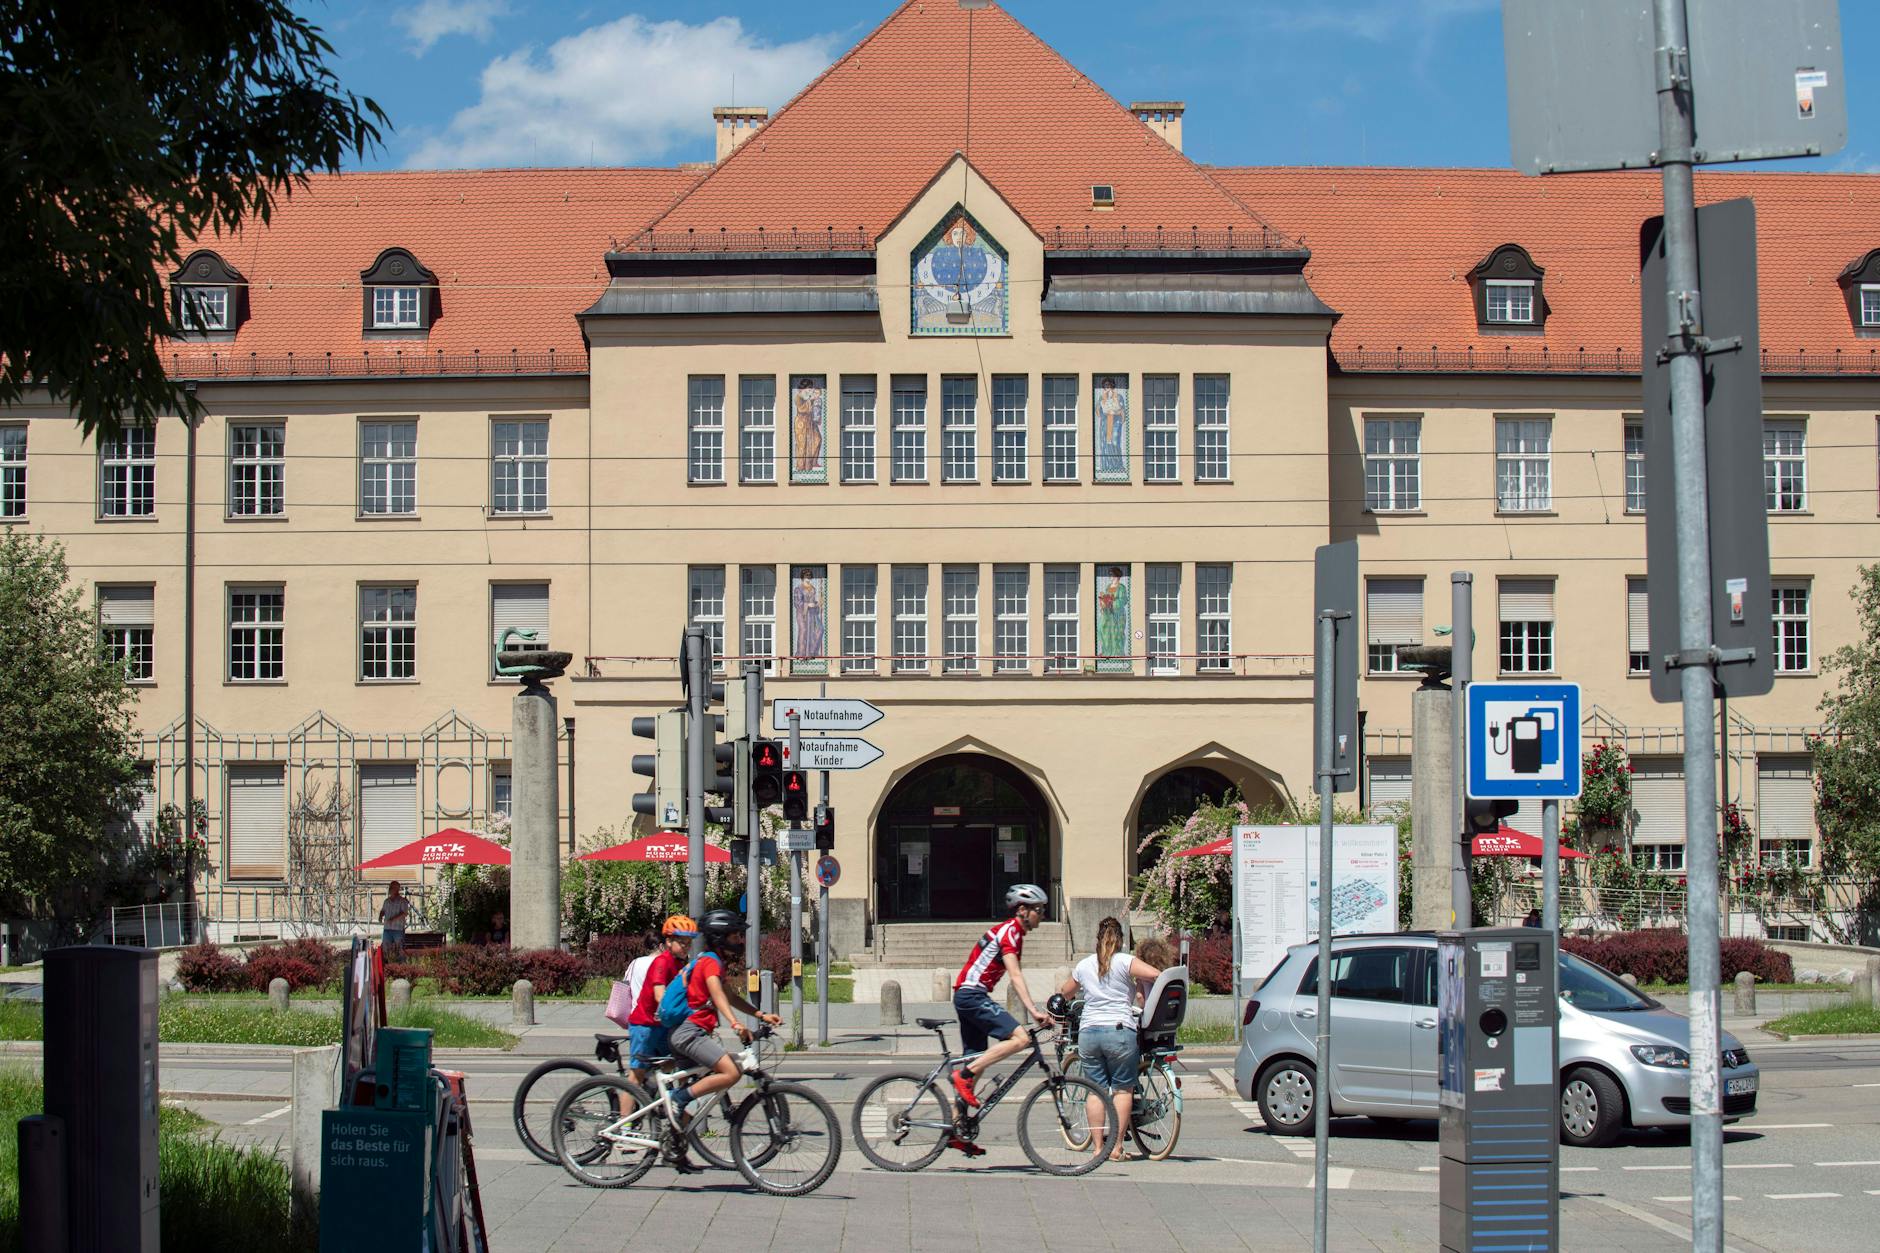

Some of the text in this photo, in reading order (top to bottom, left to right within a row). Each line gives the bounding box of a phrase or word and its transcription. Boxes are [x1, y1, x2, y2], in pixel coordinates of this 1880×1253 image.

[804, 710, 863, 720] Notaufnahme
[800, 741, 858, 752] Notaufnahme
[814, 755, 843, 765] Kinder
[331, 1123, 389, 1136] Holen Sie
[331, 1139, 410, 1152] das Beste für
[331, 1155, 389, 1167] sich raus.
